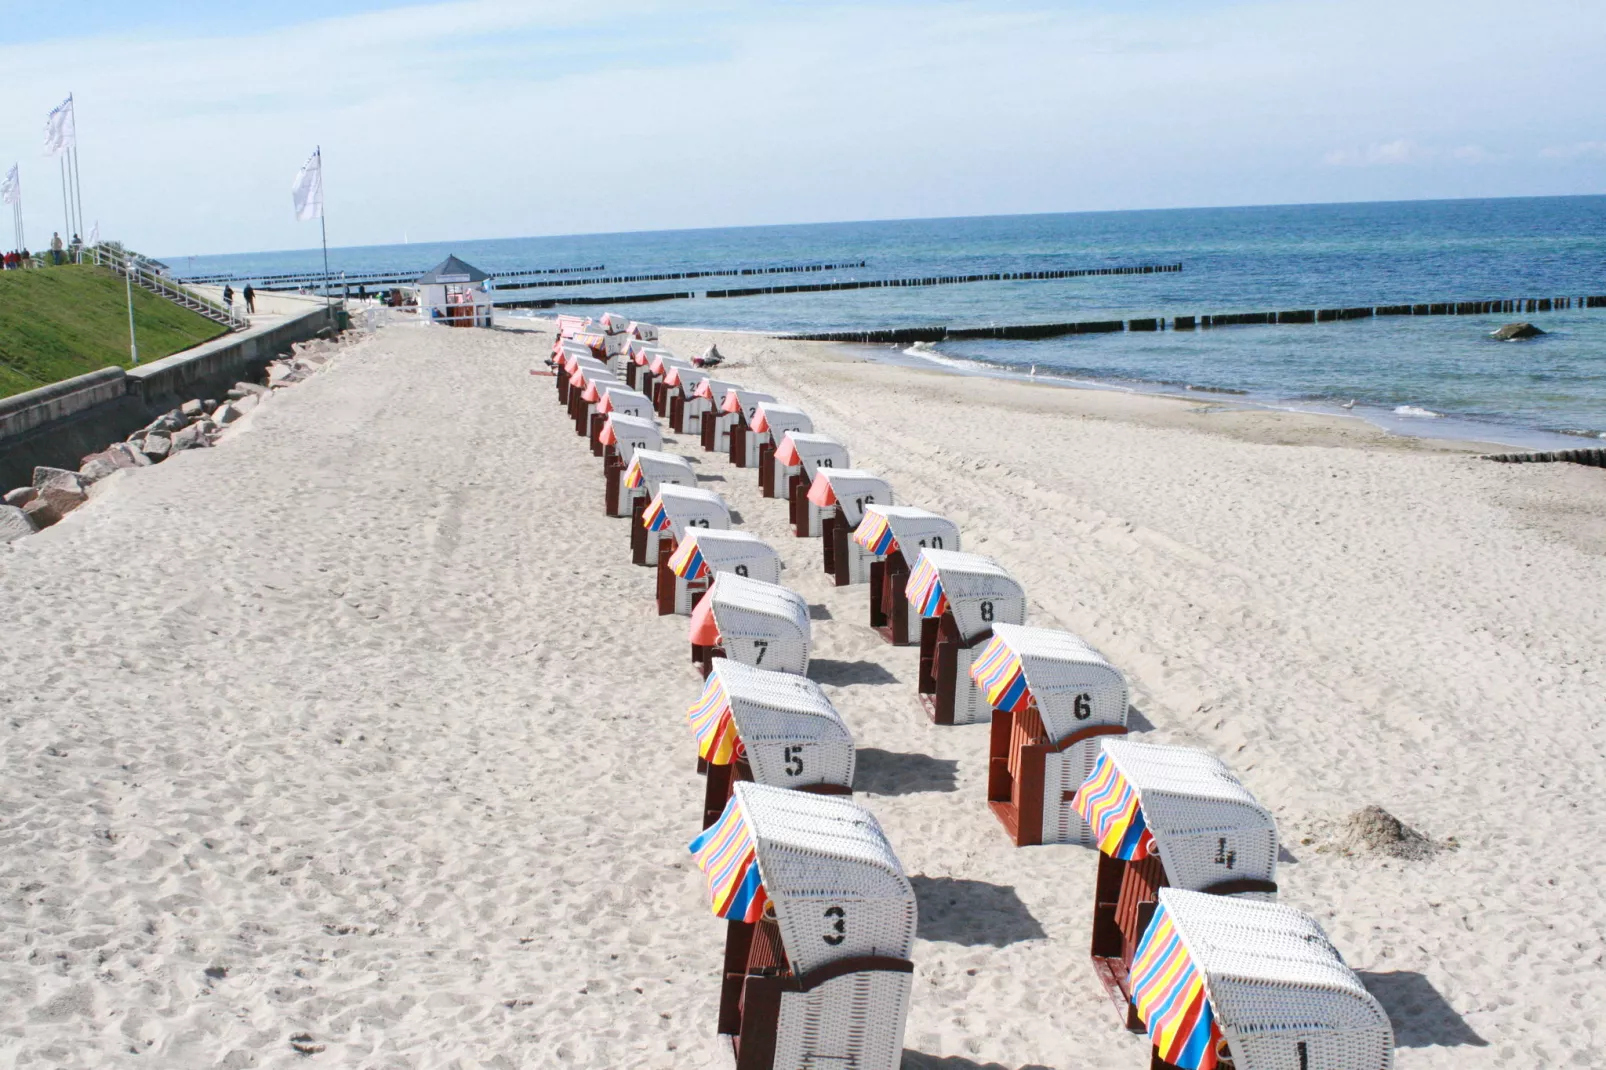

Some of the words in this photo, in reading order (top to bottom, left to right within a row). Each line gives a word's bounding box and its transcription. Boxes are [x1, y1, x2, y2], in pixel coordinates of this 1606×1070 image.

[980, 601, 994, 622] 8
[754, 640, 768, 665] 7
[1074, 692, 1092, 720] 6
[784, 746, 804, 777] 5
[1214, 837, 1236, 870] 4
[822, 906, 846, 946] 3
[1296, 1041, 1308, 1070] 1
